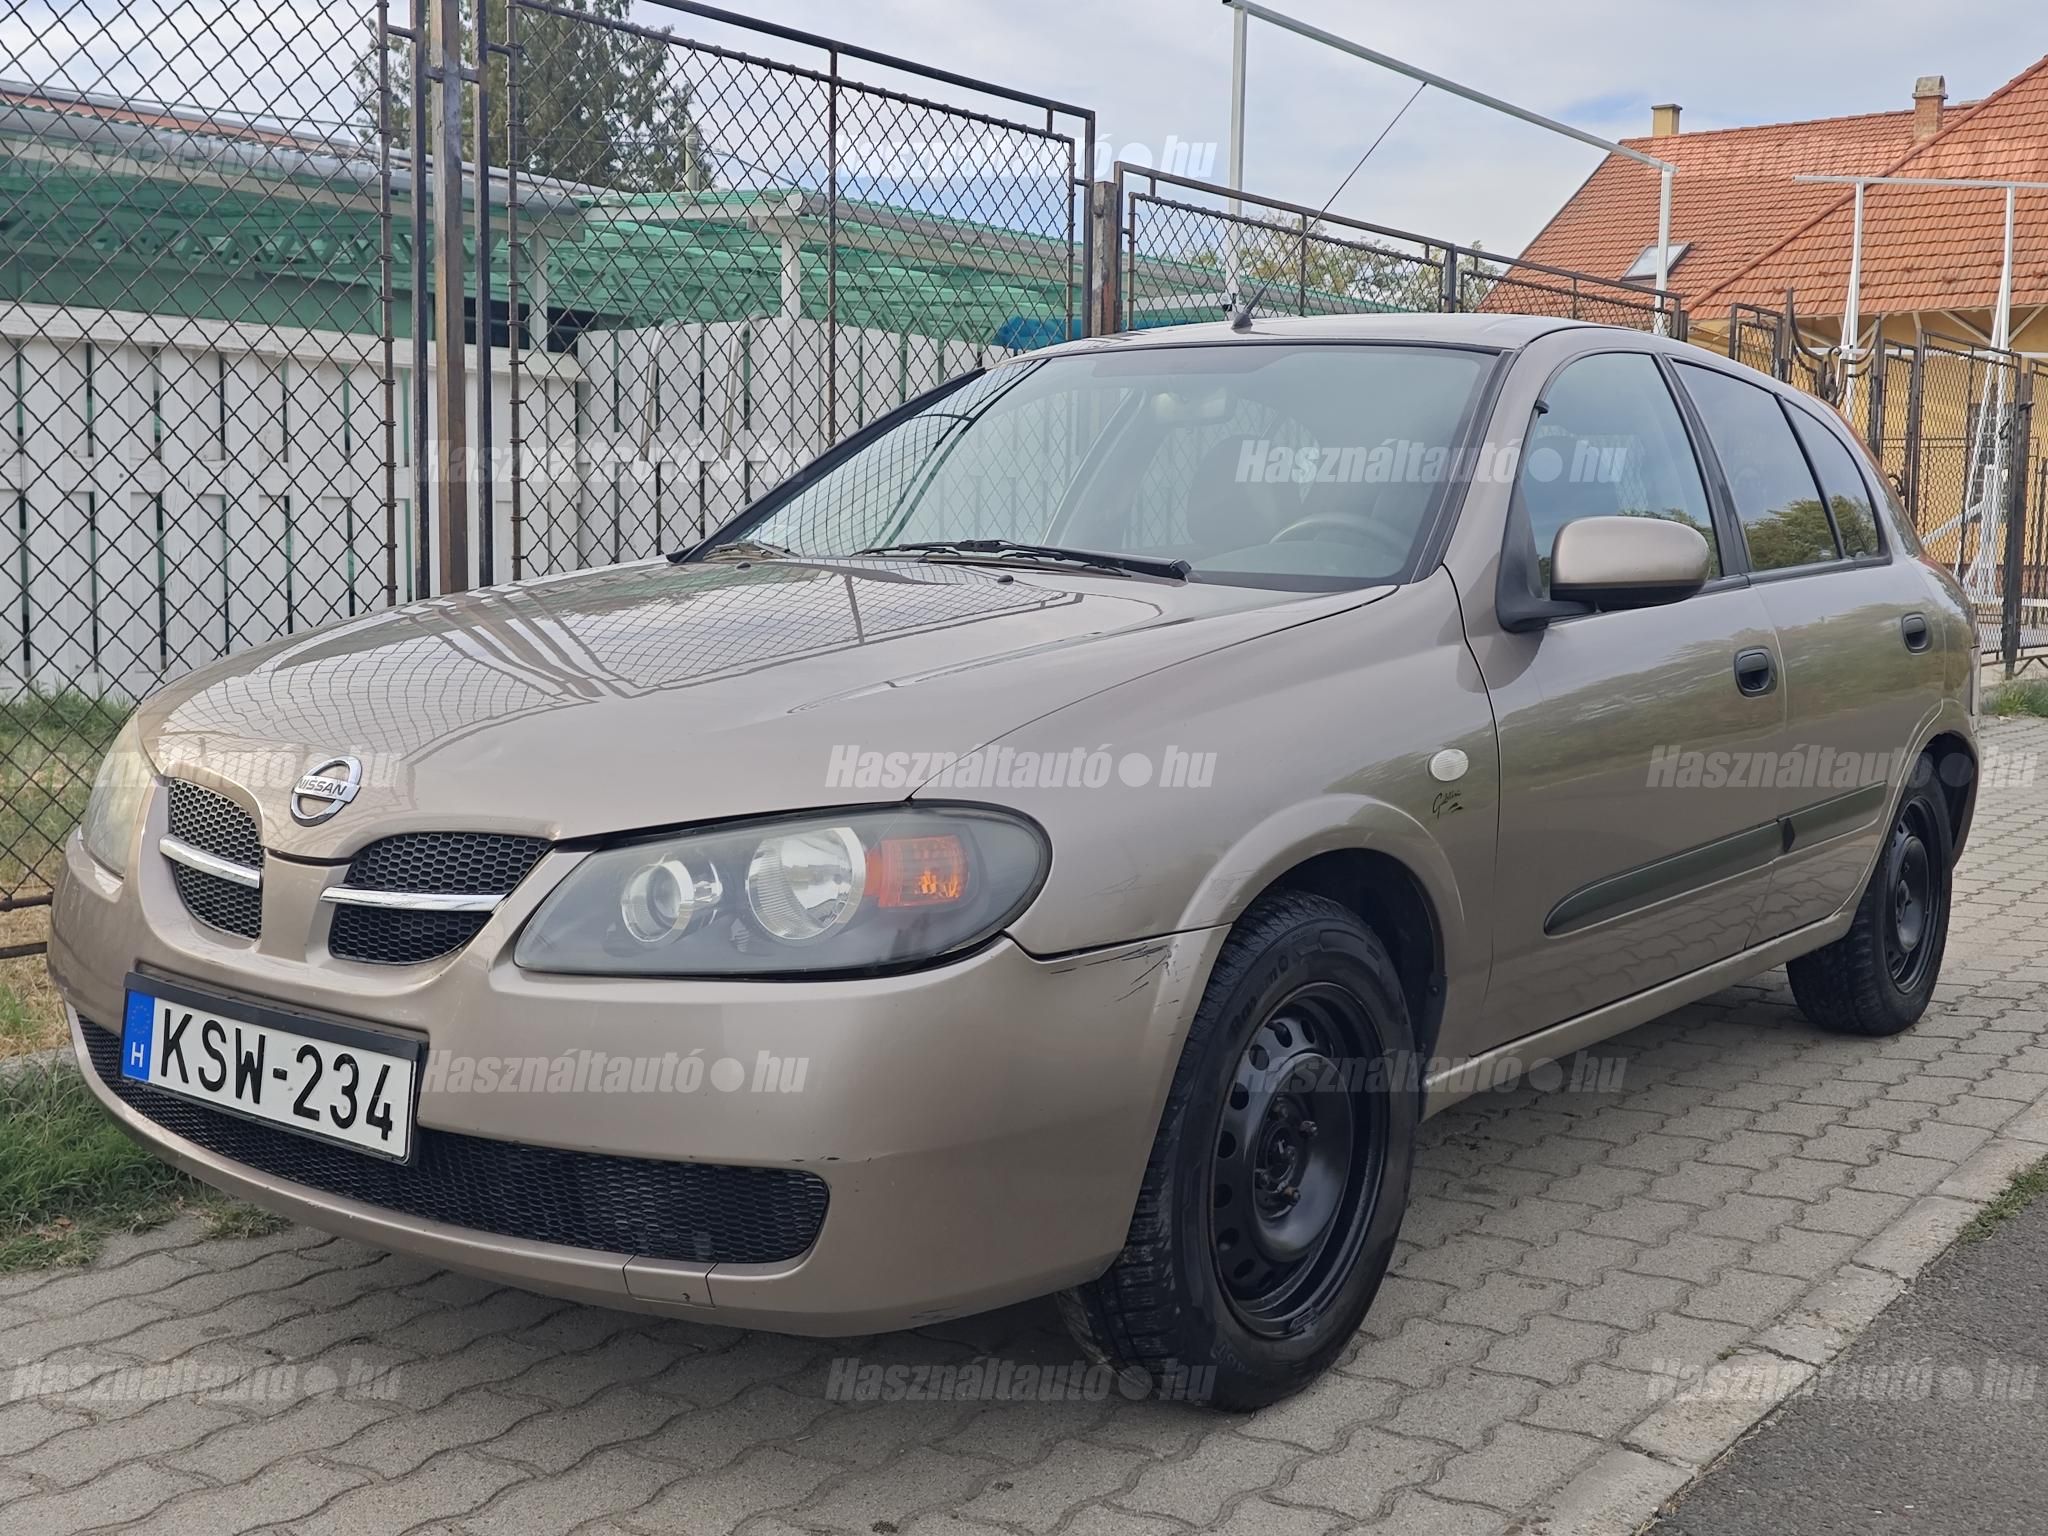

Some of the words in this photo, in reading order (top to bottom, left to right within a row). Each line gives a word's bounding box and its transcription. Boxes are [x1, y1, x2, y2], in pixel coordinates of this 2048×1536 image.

[299, 779, 347, 796] NISSAN
[131, 1041, 145, 1068] H
[160, 1008, 393, 1141] KSW-234
